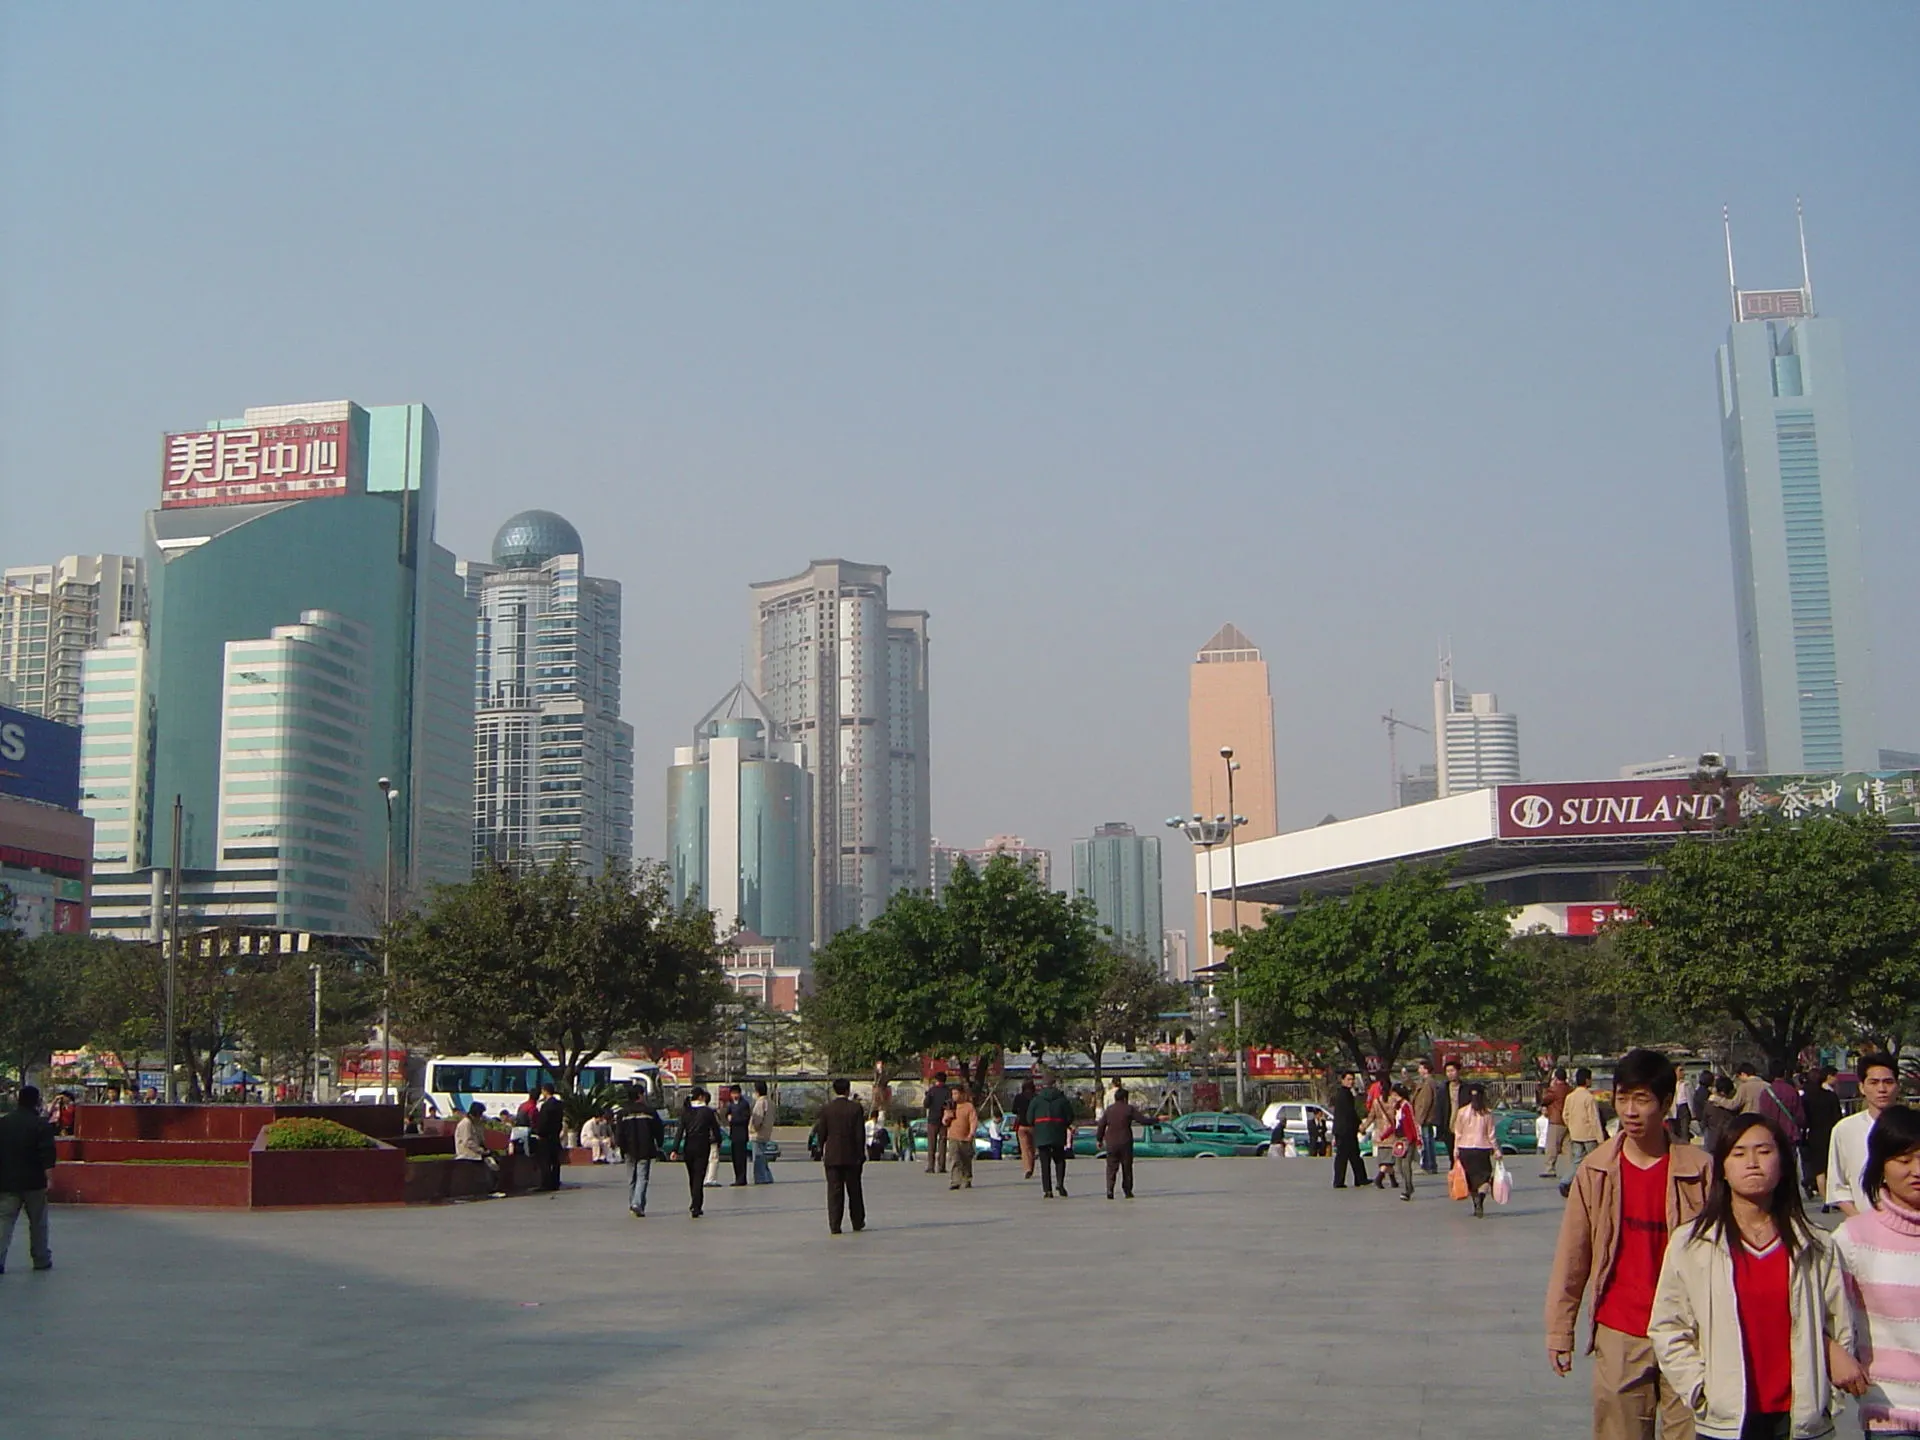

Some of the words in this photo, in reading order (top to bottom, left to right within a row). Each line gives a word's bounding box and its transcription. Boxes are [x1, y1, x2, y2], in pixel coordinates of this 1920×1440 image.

[168, 431, 338, 486] 美居中心
[1559, 793, 1725, 826] SUNLAND
